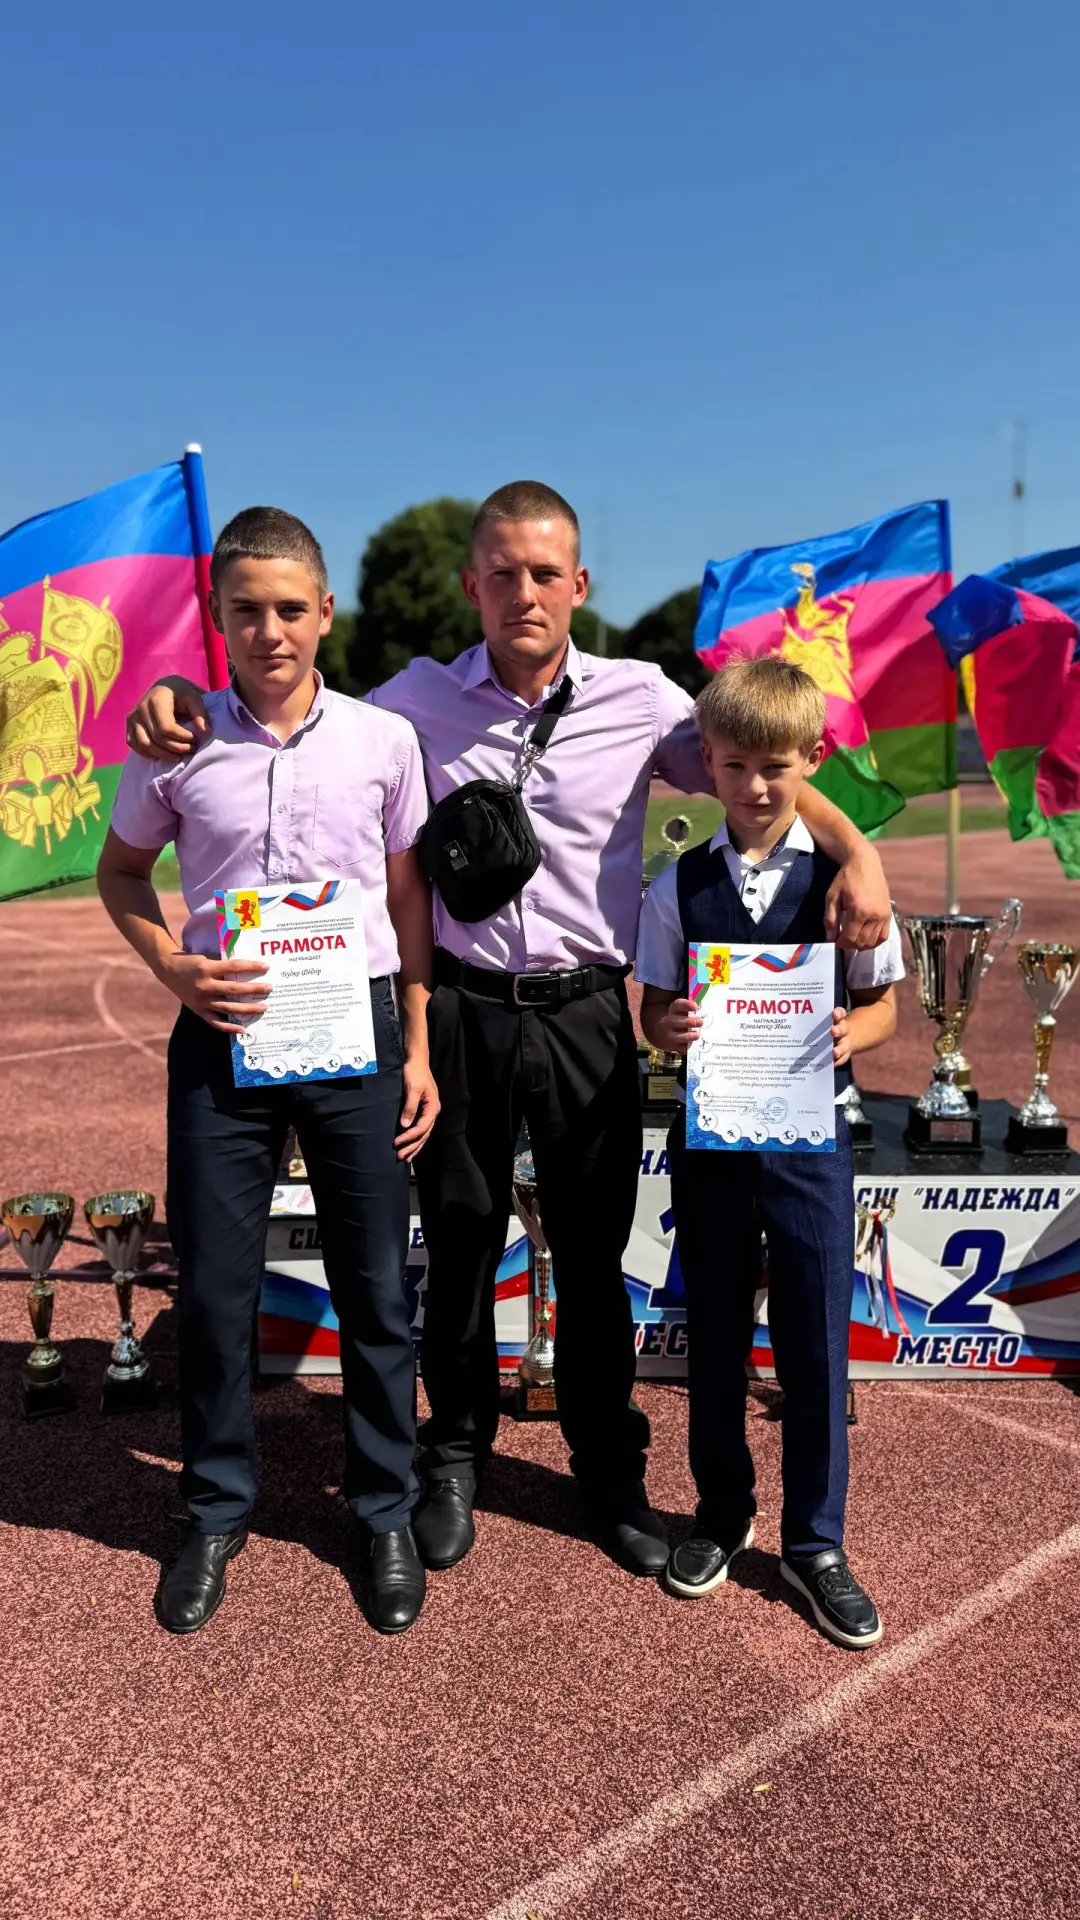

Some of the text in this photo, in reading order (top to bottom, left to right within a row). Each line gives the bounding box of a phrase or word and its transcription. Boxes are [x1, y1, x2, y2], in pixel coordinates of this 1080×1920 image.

[260, 934, 347, 956] ГРАМОТА
[726, 999, 814, 1015] ГРАМОТА
[912, 1187, 1076, 1213] "НАДЕЖДА"
[927, 1228, 1006, 1325] 2
[895, 1335, 1022, 1365] МЕСТО
